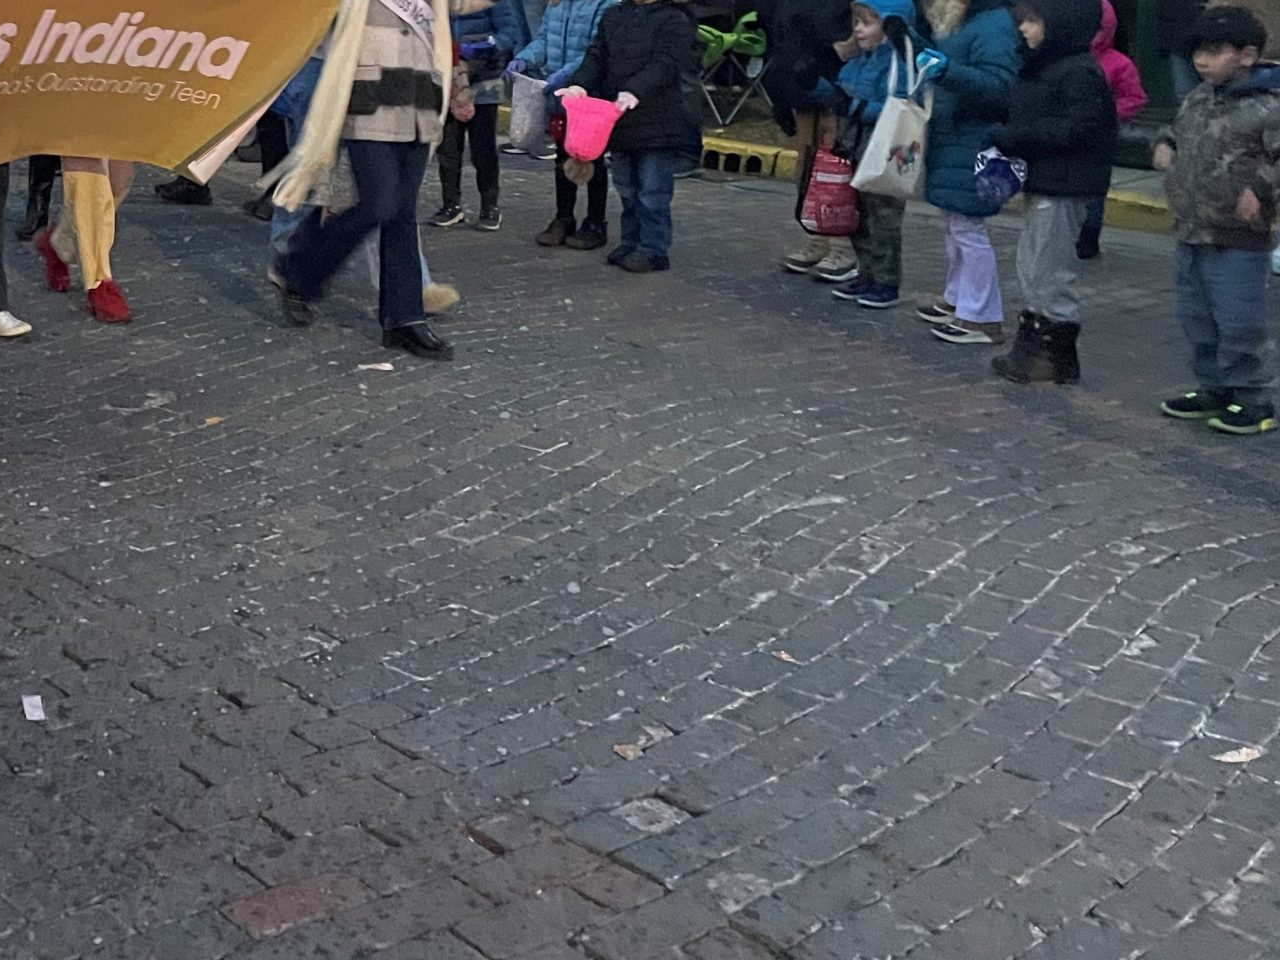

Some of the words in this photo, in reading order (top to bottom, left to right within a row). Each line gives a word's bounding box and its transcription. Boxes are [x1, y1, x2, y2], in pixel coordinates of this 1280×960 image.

[20, 9, 250, 81] Indiana
[36, 72, 166, 102] Outstanding
[170, 81, 222, 110] Teen
